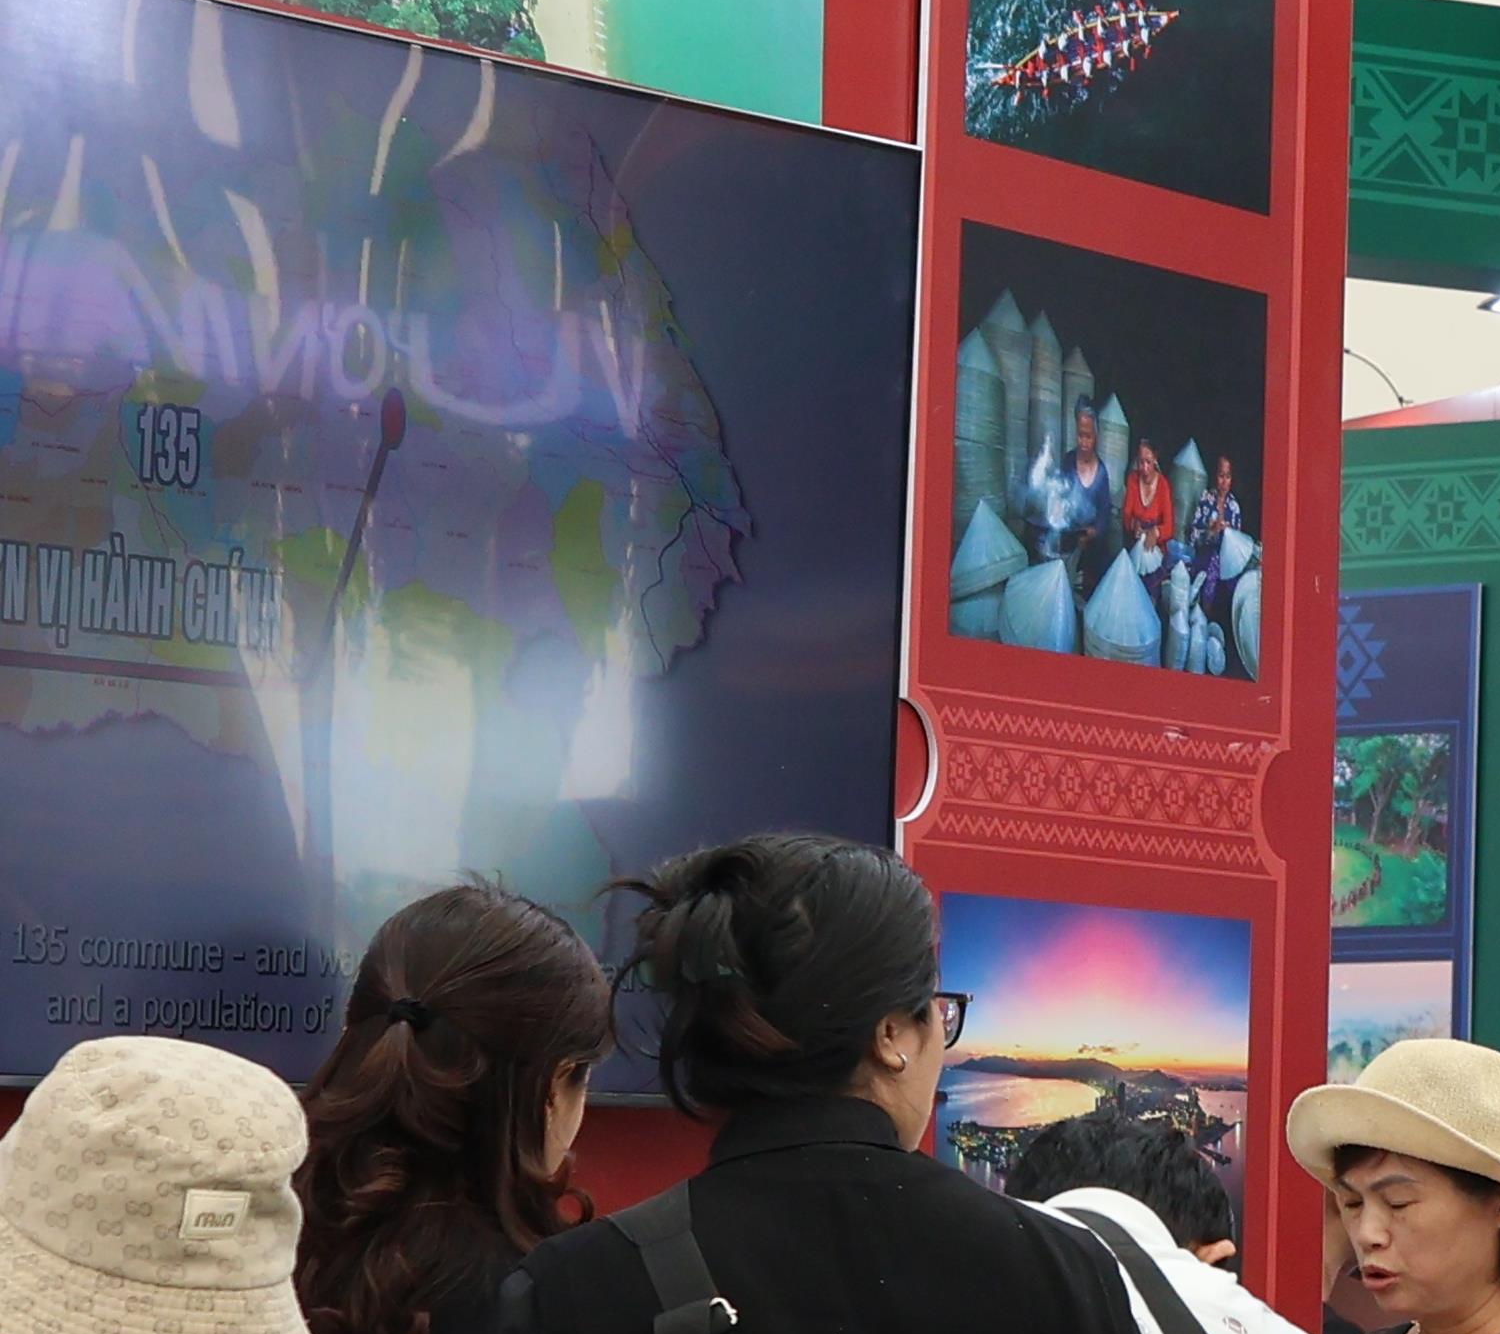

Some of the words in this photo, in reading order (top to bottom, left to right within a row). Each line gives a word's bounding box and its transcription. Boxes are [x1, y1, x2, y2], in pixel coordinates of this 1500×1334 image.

[137, 403, 202, 489] 135
[0, 538, 30, 624] N
[37, 543, 73, 648] VỊ
[79, 532, 176, 640] HÀNH
[12, 922, 69, 965] 135
[78, 937, 225, 973] commune
[254, 937, 309, 977] and
[47, 984, 104, 1026] and
[113, 995, 132, 1028] a
[142, 989, 294, 1038] population
